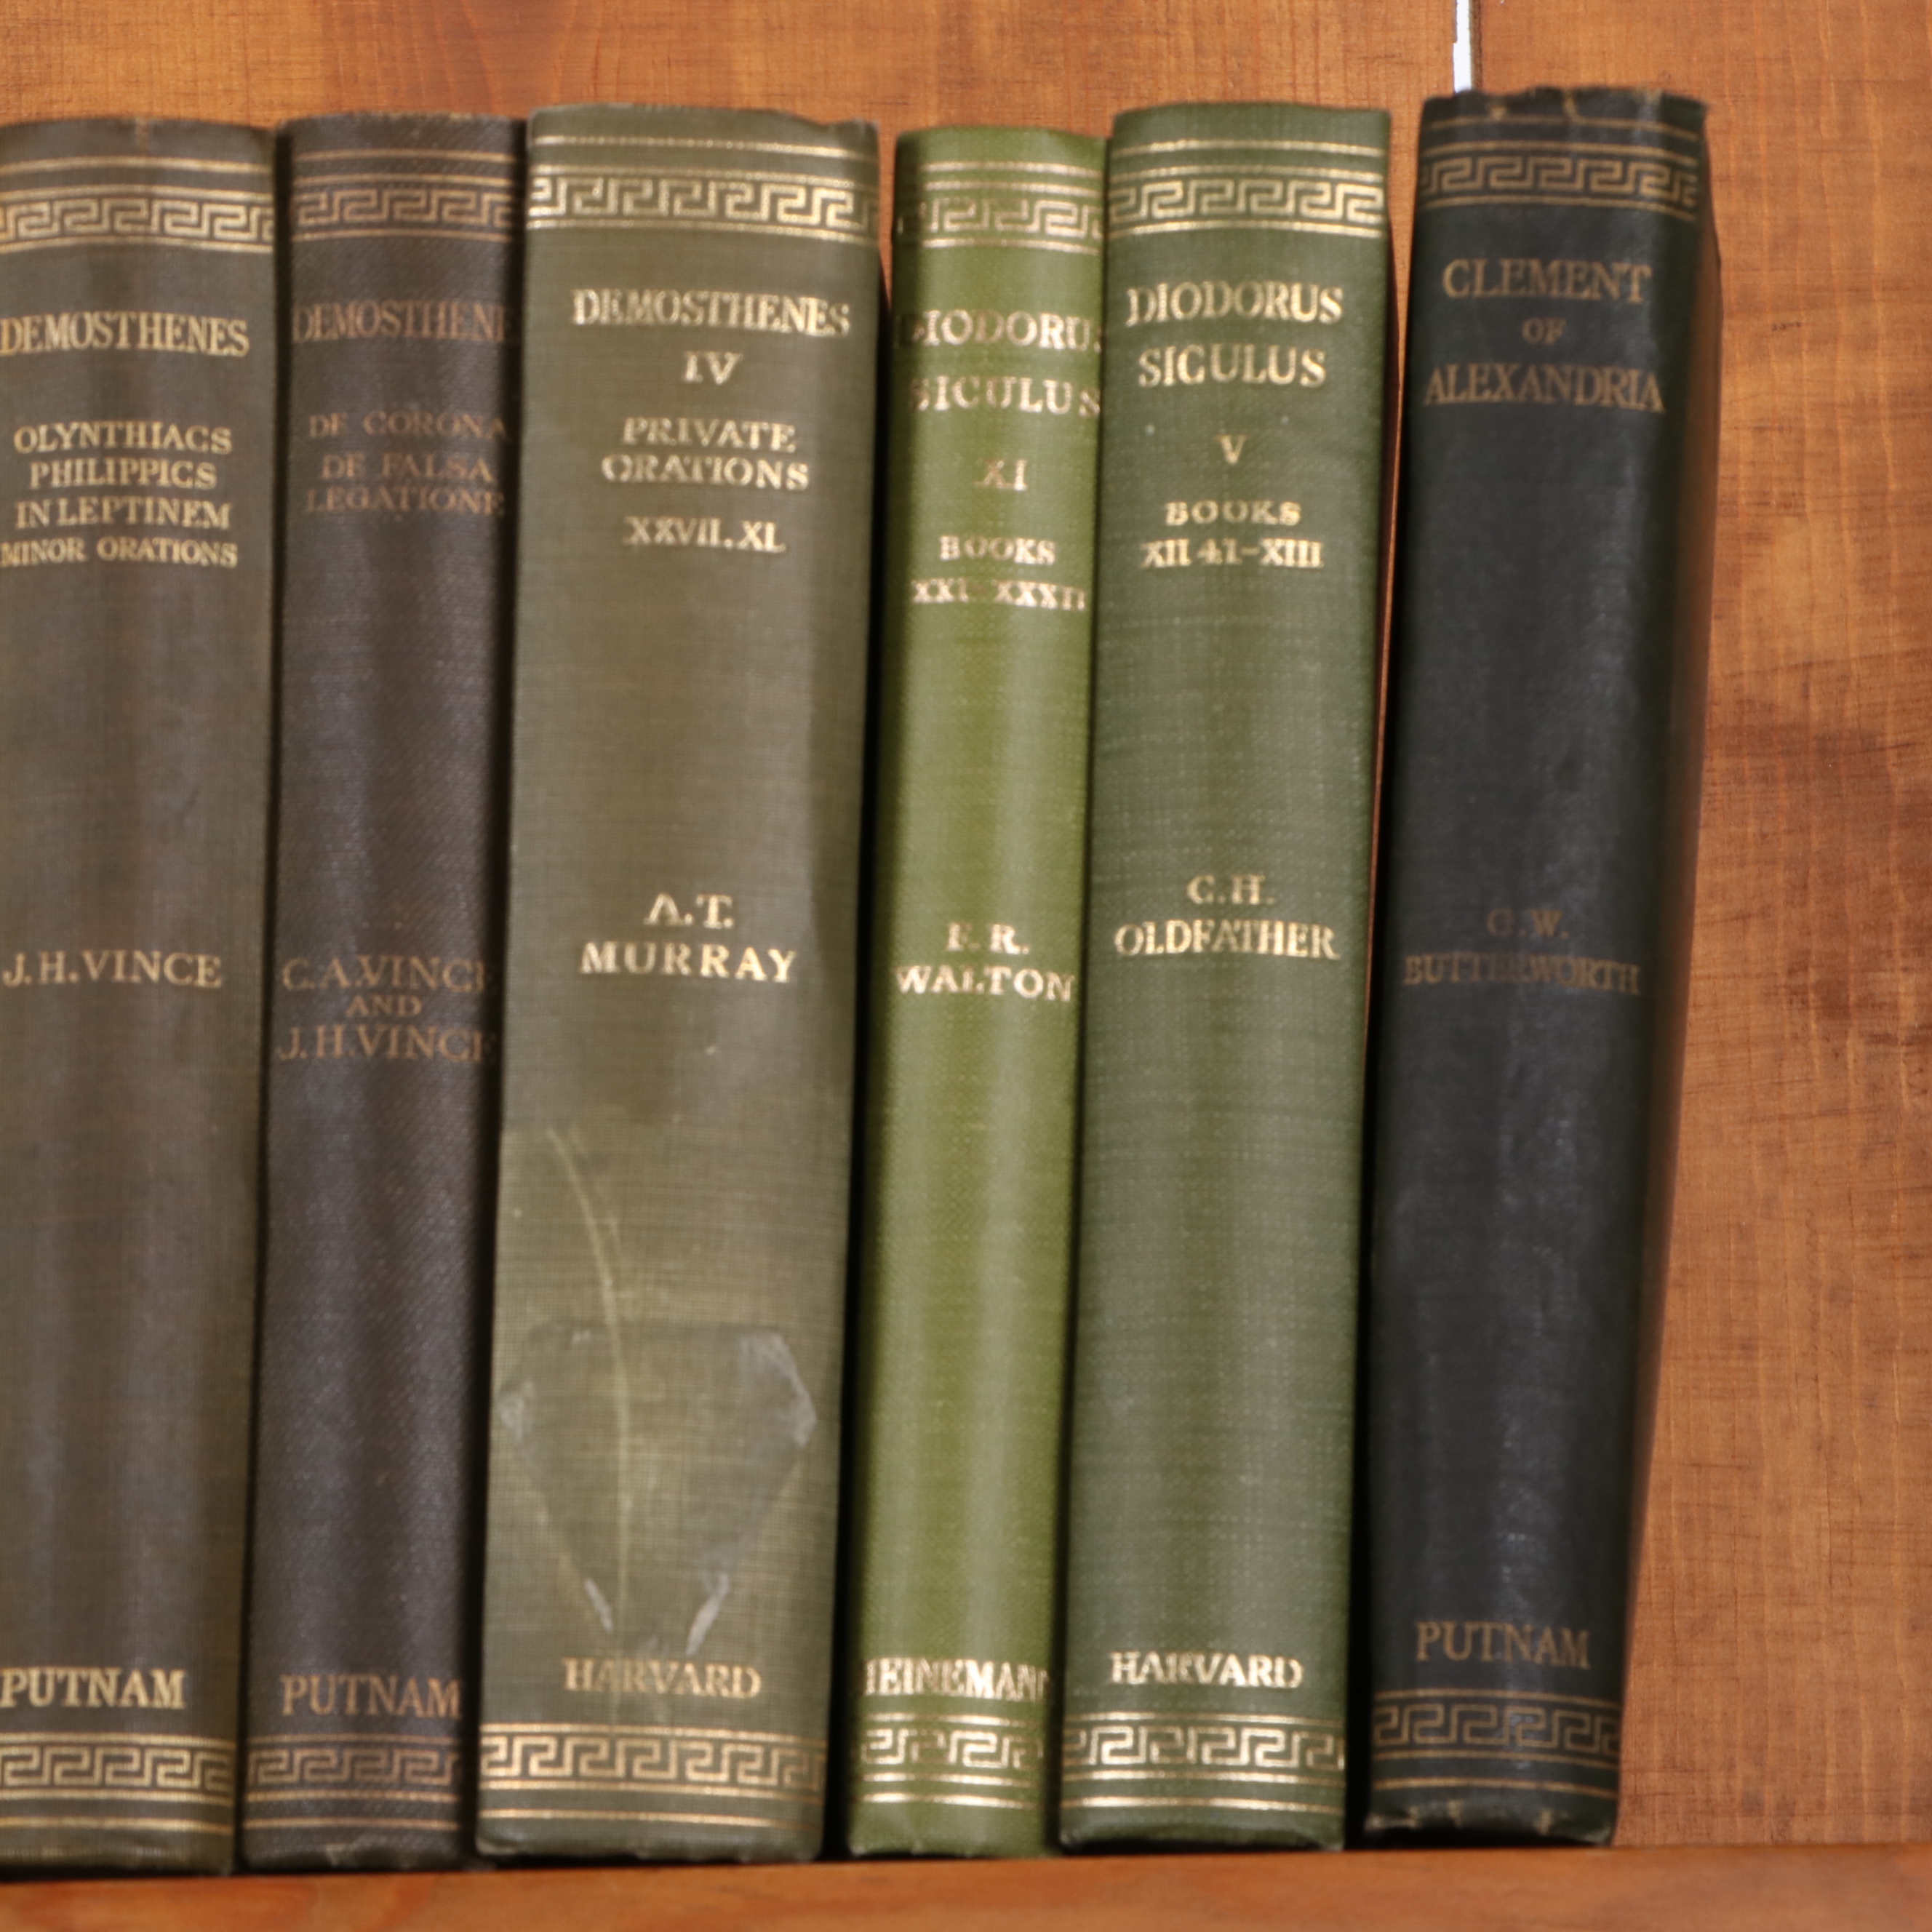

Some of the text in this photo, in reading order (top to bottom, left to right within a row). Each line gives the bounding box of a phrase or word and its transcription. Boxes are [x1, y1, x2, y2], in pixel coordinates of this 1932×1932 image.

[1442, 258, 1653, 304] CLEMENT
[292, 298, 507, 343] DEMOSTHEN
[572, 289, 850, 337] DEMOSTHENES
[1126, 280, 1344, 327] DIODORUS
[0, 311, 250, 357] DEMOSTHENES
[895, 308, 1101, 353] IODORU
[1522, 317, 1567, 345] OF
[681, 351, 743, 386] IV
[1138, 343, 1328, 388] SICULUS
[1424, 362, 1666, 415] ALEXANDRIA
[13, 420, 233, 455] OLYNTHIACS
[309, 412, 348, 437] DE
[622, 417, 797, 452] PRIVATE
[322, 451, 494, 483] DE FALSA
[1218, 434, 1248, 466] V
[31, 457, 217, 490] PHILIPPICS
[601, 453, 810, 490] ORATIONS
[975, 458, 1028, 492] XI
[15, 495, 231, 530] IN LEPTINEM
[1165, 499, 1303, 527] BOOKS
[0, 535, 239, 569] MINOR ORATIONS
[939, 535, 1056, 565] BOOKS
[1139, 538, 1191, 570] XII
[646, 893, 734, 930] A.T.
[1113, 919, 1340, 961] OLDFATHER
[580, 941, 796, 984] MURRAY
[894, 965, 1077, 1002] WALTON
[345, 994, 423, 1018] AND
[1415, 1621, 1592, 1670] PUTNAM
[0, 1666, 187, 1710] PUTNAM
[561, 1657, 763, 1700] HARVARD
[1109, 1650, 1305, 1690] HARVARD
[280, 1674, 463, 1720] PUTNAM
